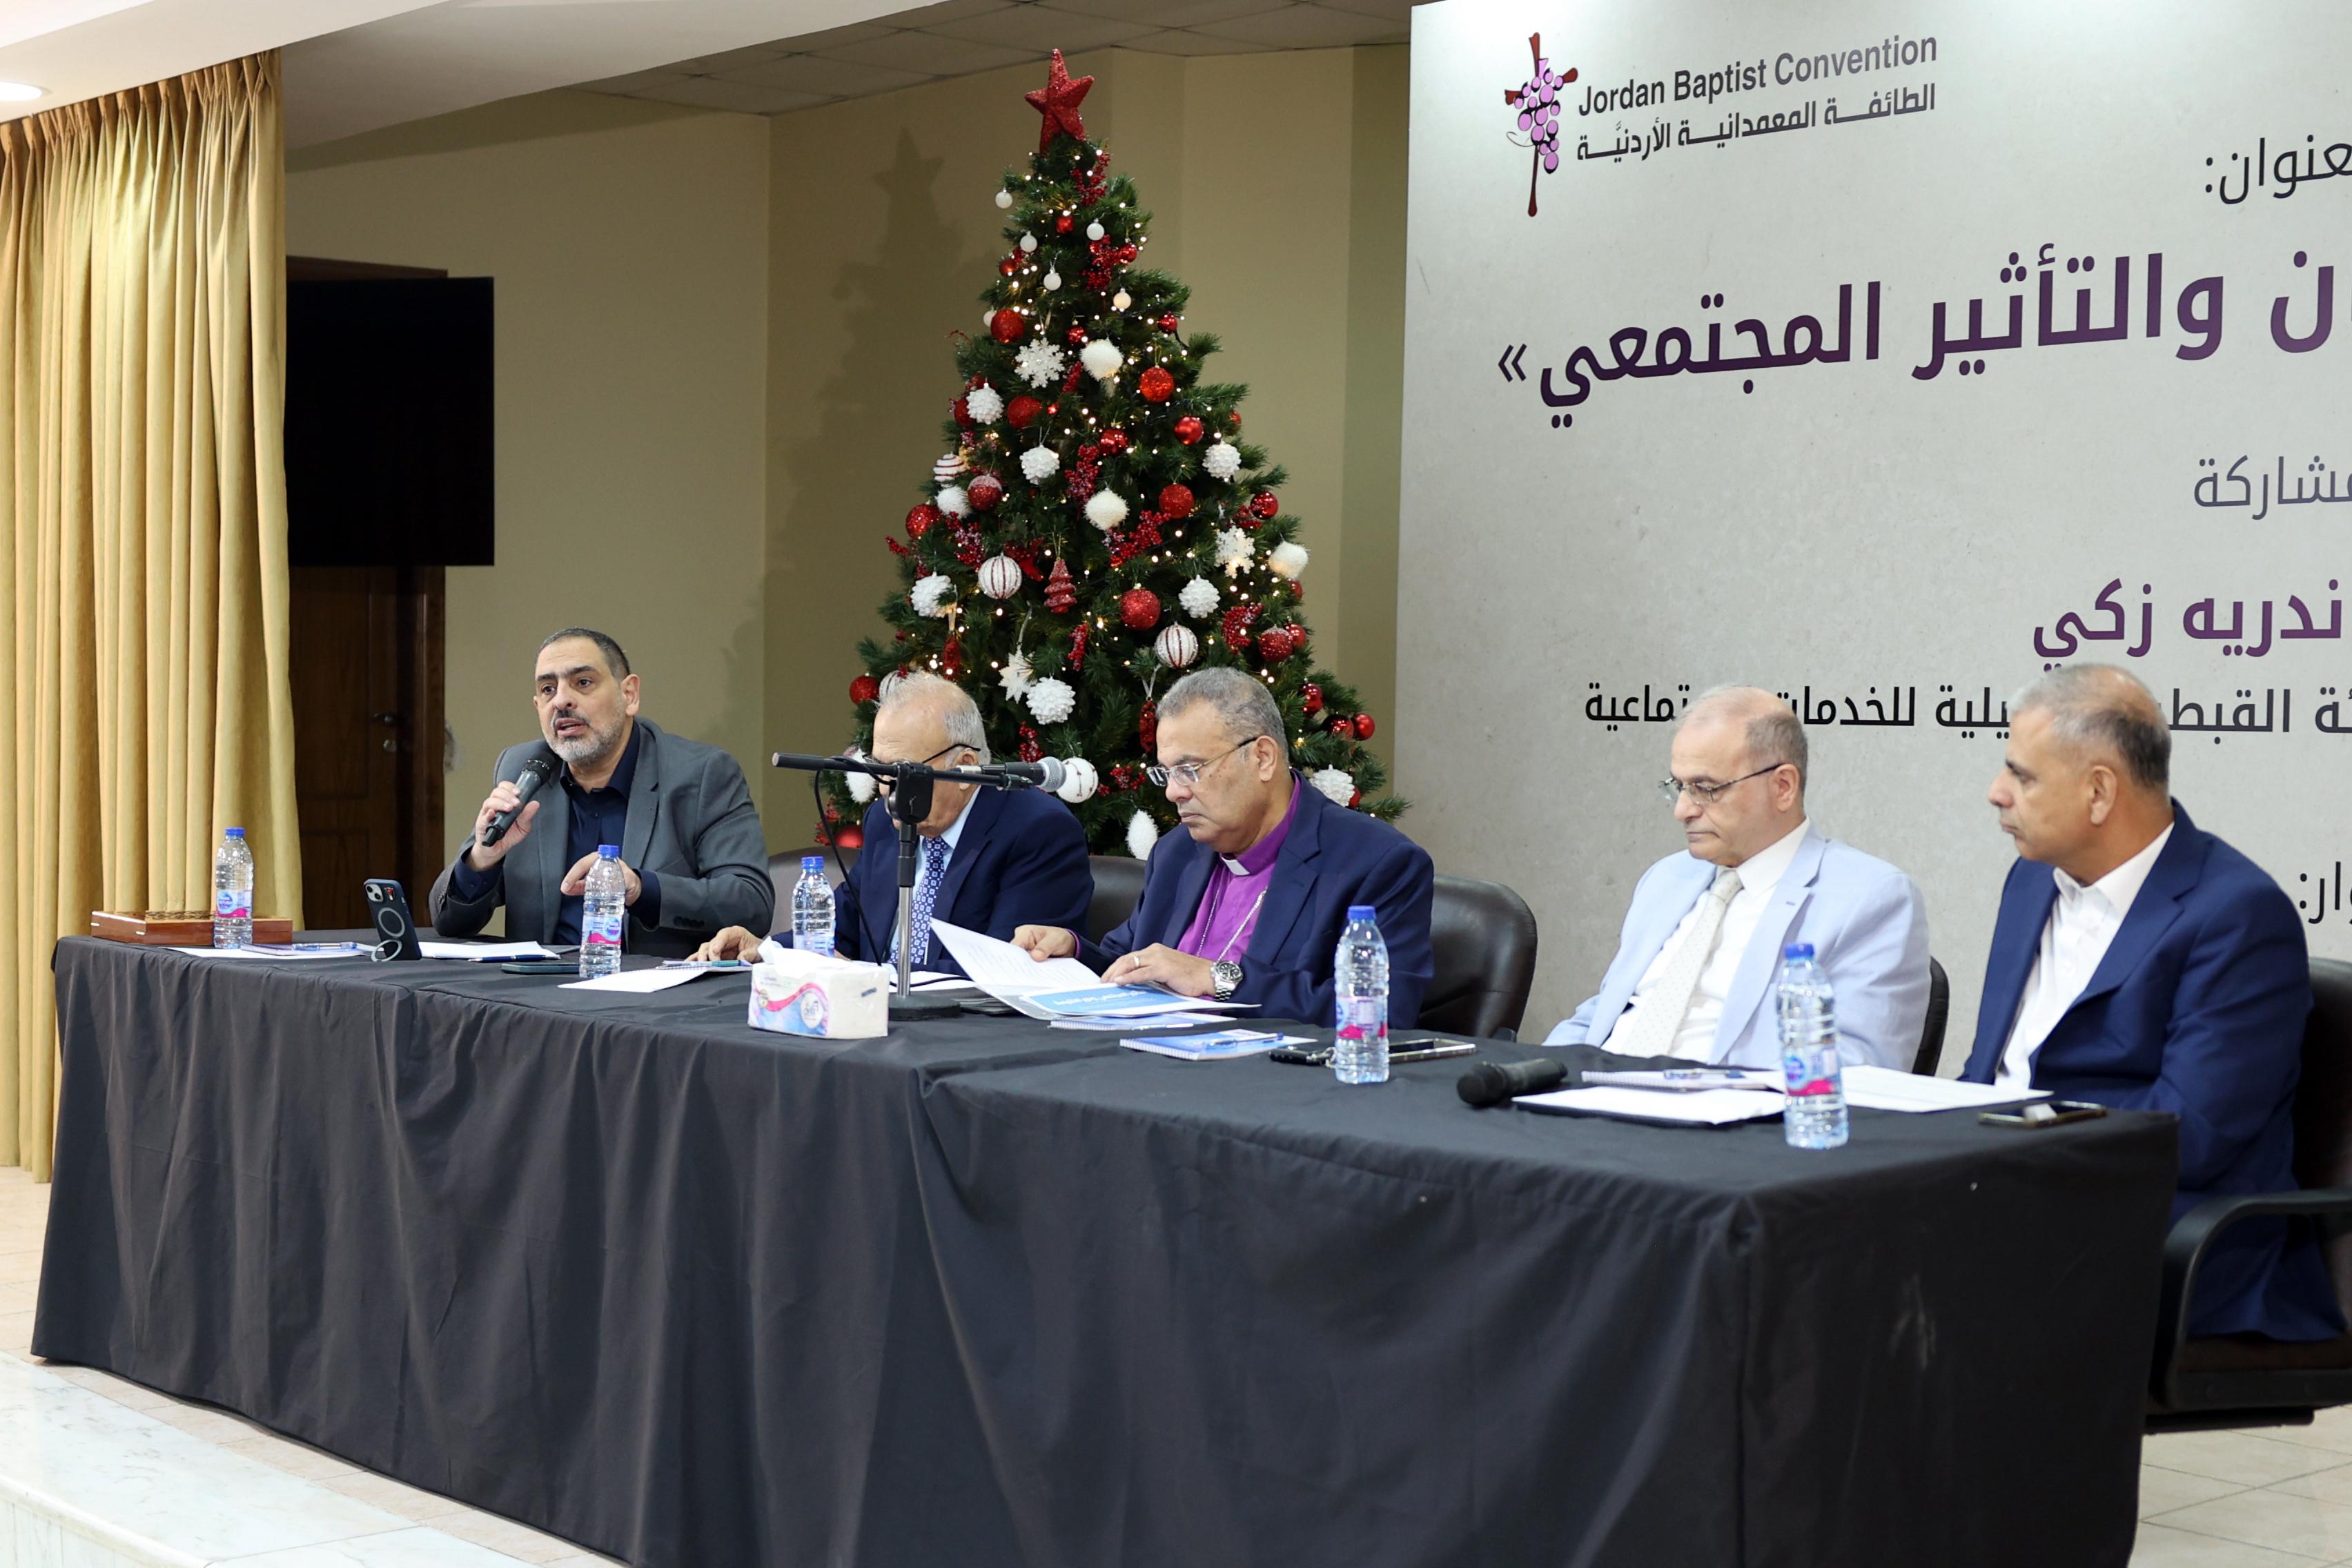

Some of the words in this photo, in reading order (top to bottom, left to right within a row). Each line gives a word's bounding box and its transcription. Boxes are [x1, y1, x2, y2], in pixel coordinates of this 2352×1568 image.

[1578, 78, 1665, 117] Jordan
[1674, 59, 1767, 105] Baptist
[1774, 35, 1937, 86] Convention
[2205, 134, 2352, 205] عنوان:
[1910, 242, 2224, 381] والتأثير
[2194, 455, 2352, 520] شاركة
[2033, 578, 2153, 672] زكي
[1585, 682, 1690, 732] تماعية
[1934, 686, 2010, 740] يلية
[2167, 687, 2291, 745] القبط
[2299, 861, 2352, 925] ار:
